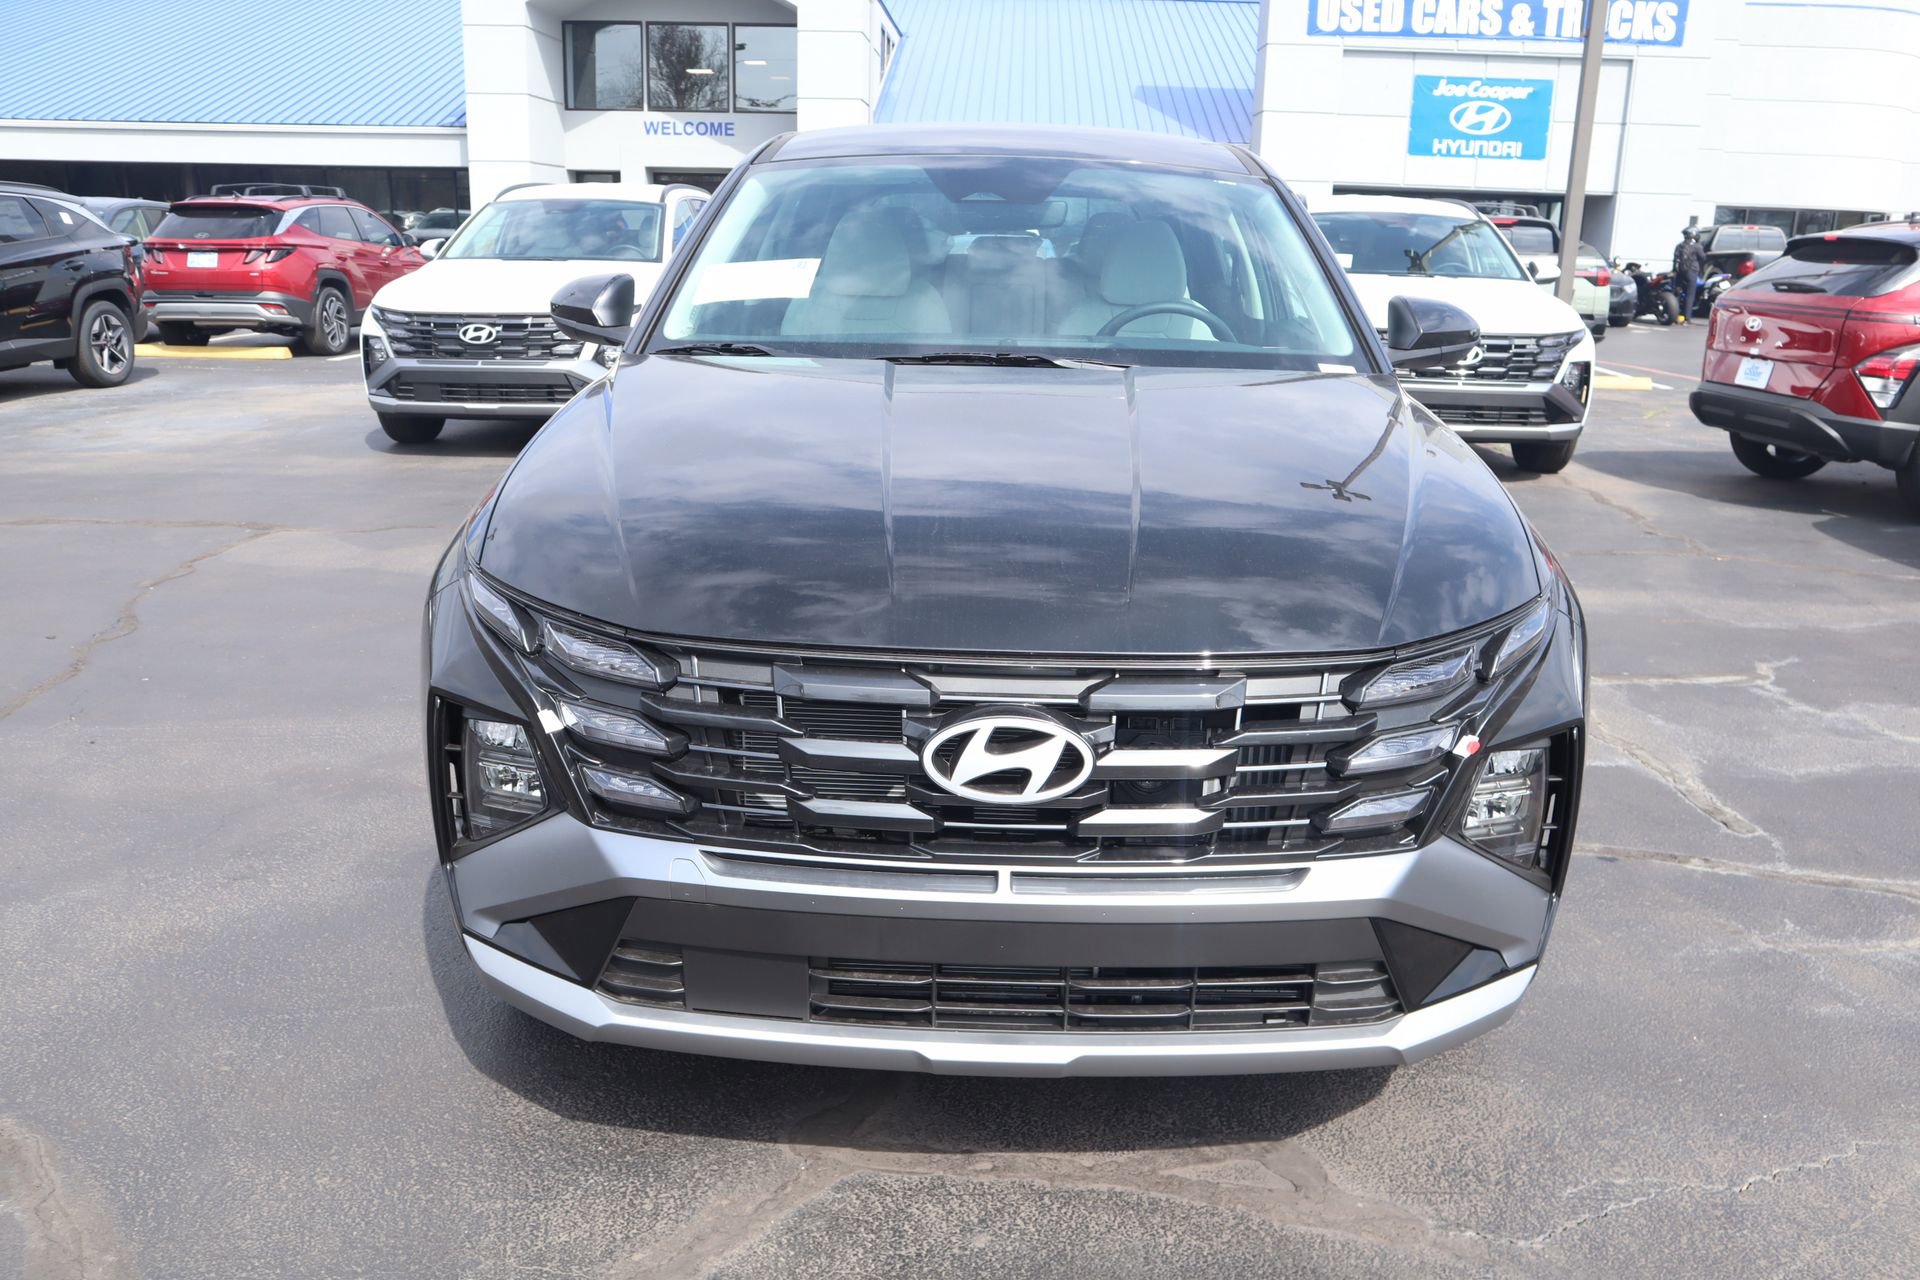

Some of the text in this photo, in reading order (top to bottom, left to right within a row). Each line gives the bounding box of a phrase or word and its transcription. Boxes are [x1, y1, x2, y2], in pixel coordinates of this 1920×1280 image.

[1316, 0, 1678, 42] USED CARS & TRCKS
[1432, 79, 1534, 100] Joe Cooper
[644, 121, 735, 136] WELCOME
[1432, 138, 1523, 157] HYUNDAI
[1726, 334, 1784, 348] KONA
